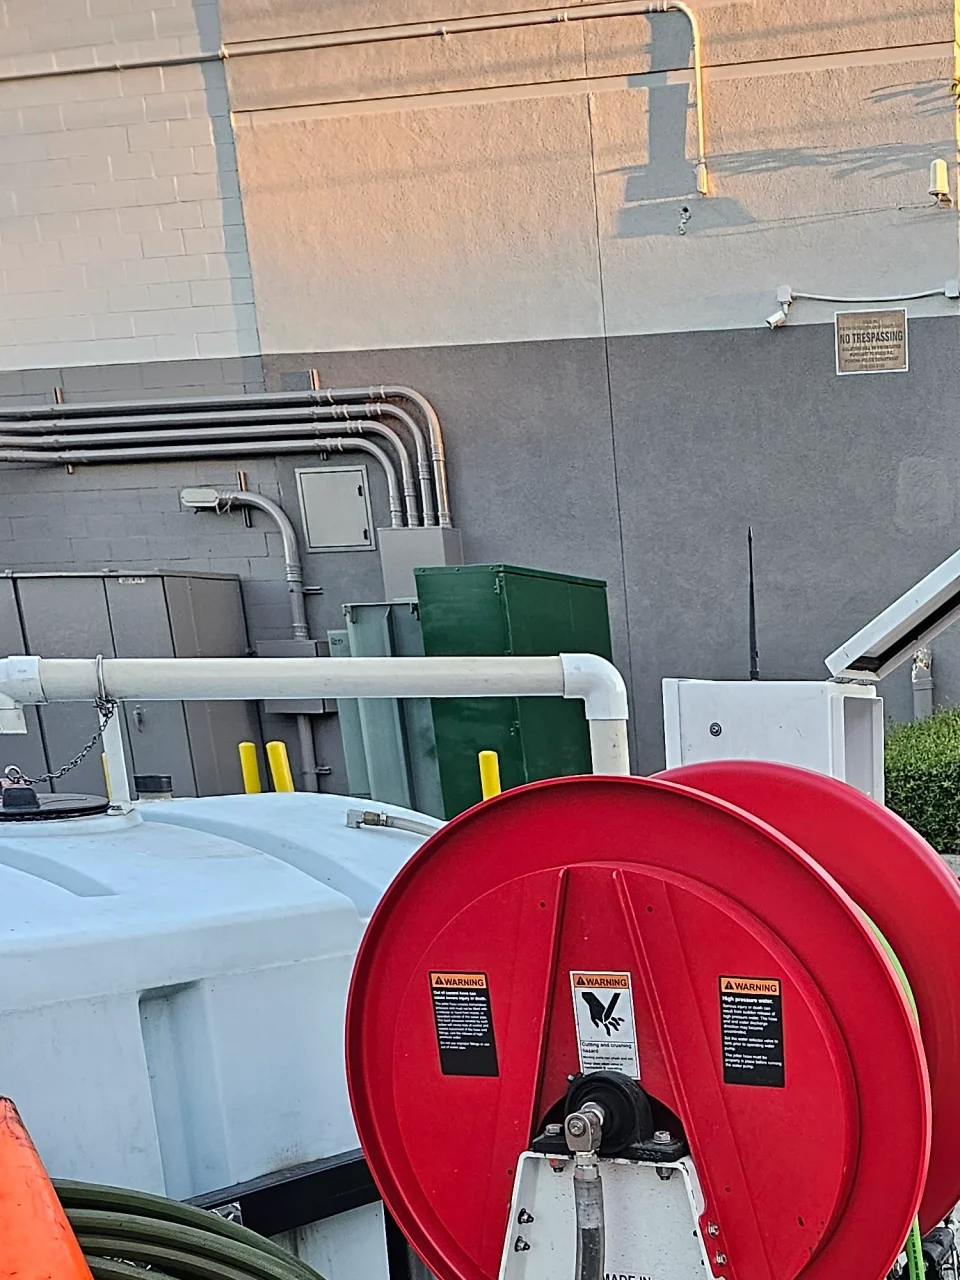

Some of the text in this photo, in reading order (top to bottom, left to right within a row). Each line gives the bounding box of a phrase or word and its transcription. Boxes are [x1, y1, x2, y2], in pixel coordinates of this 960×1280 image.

[840, 330, 902, 344] NO TRESPASSING
[444, 978, 484, 986] WARNING
[586, 978, 626, 986] WARNING
[734, 982, 777, 992] WARNING
